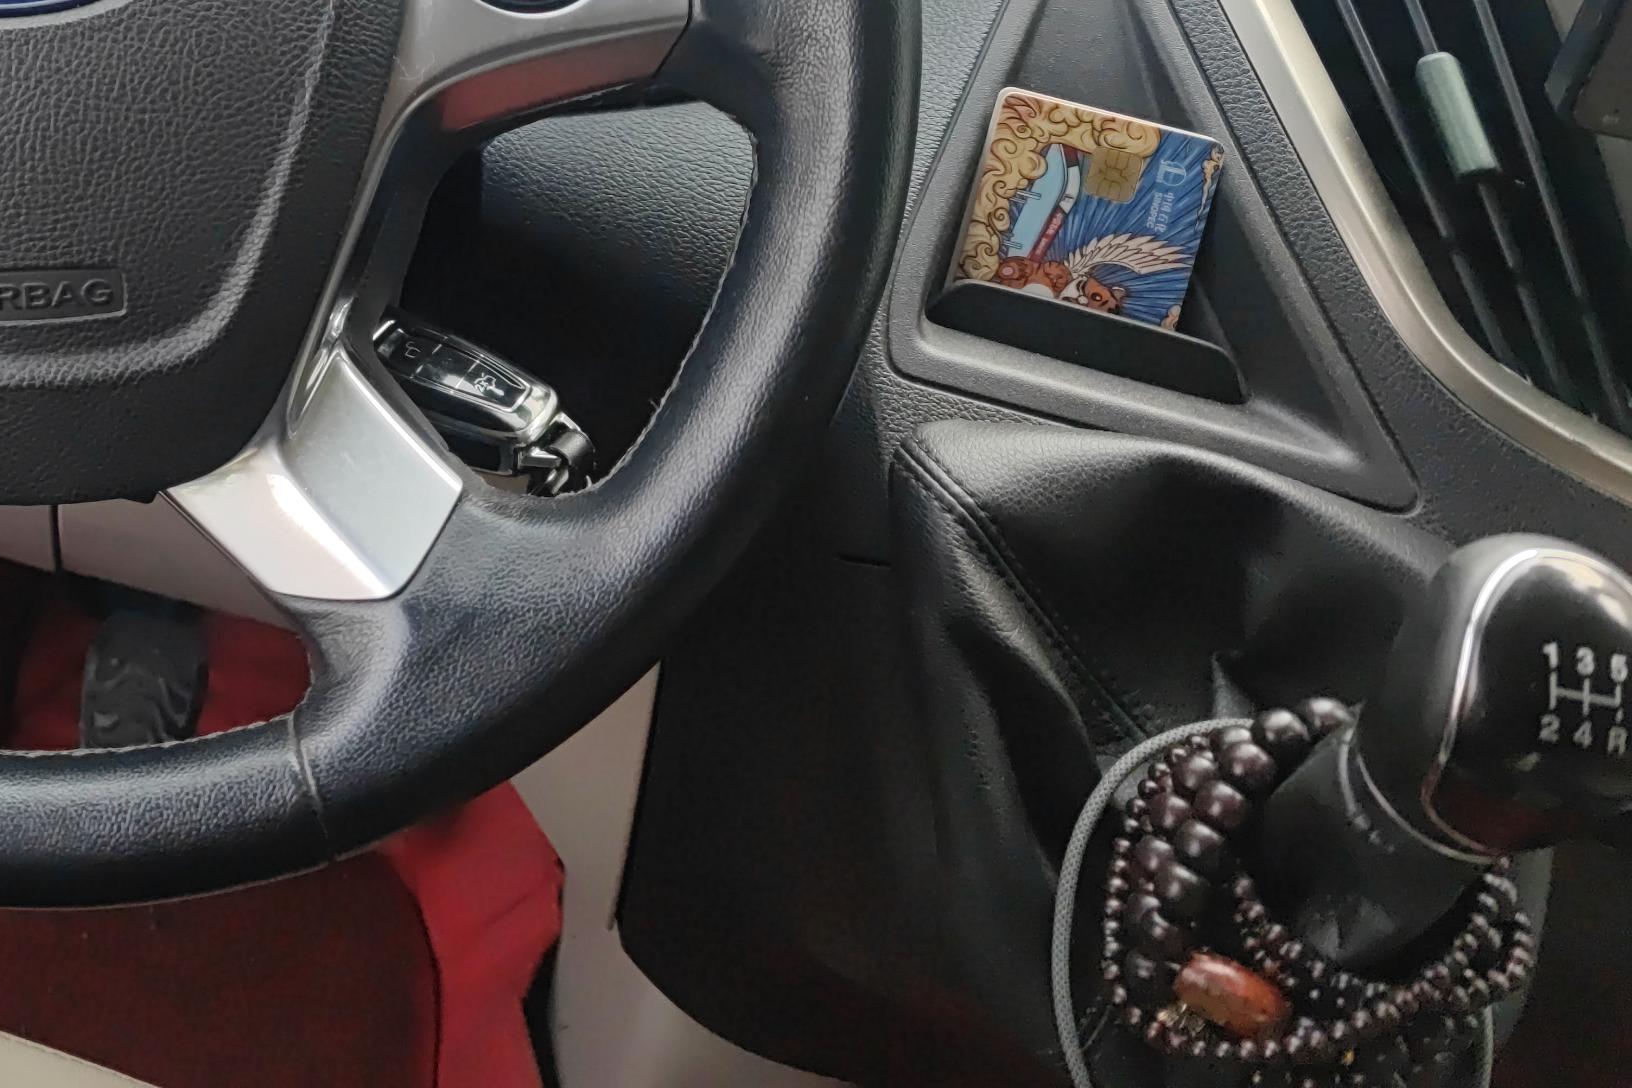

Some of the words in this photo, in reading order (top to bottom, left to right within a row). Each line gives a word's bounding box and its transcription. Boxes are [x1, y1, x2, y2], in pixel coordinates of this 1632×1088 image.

[1542, 642, 1559, 669] 1
[1576, 647, 1595, 676] 3
[1610, 653, 1628, 682] 5
[1538, 714, 1561, 743] 2
[1572, 720, 1593, 748] 4
[1607, 725, 1628, 756] R
